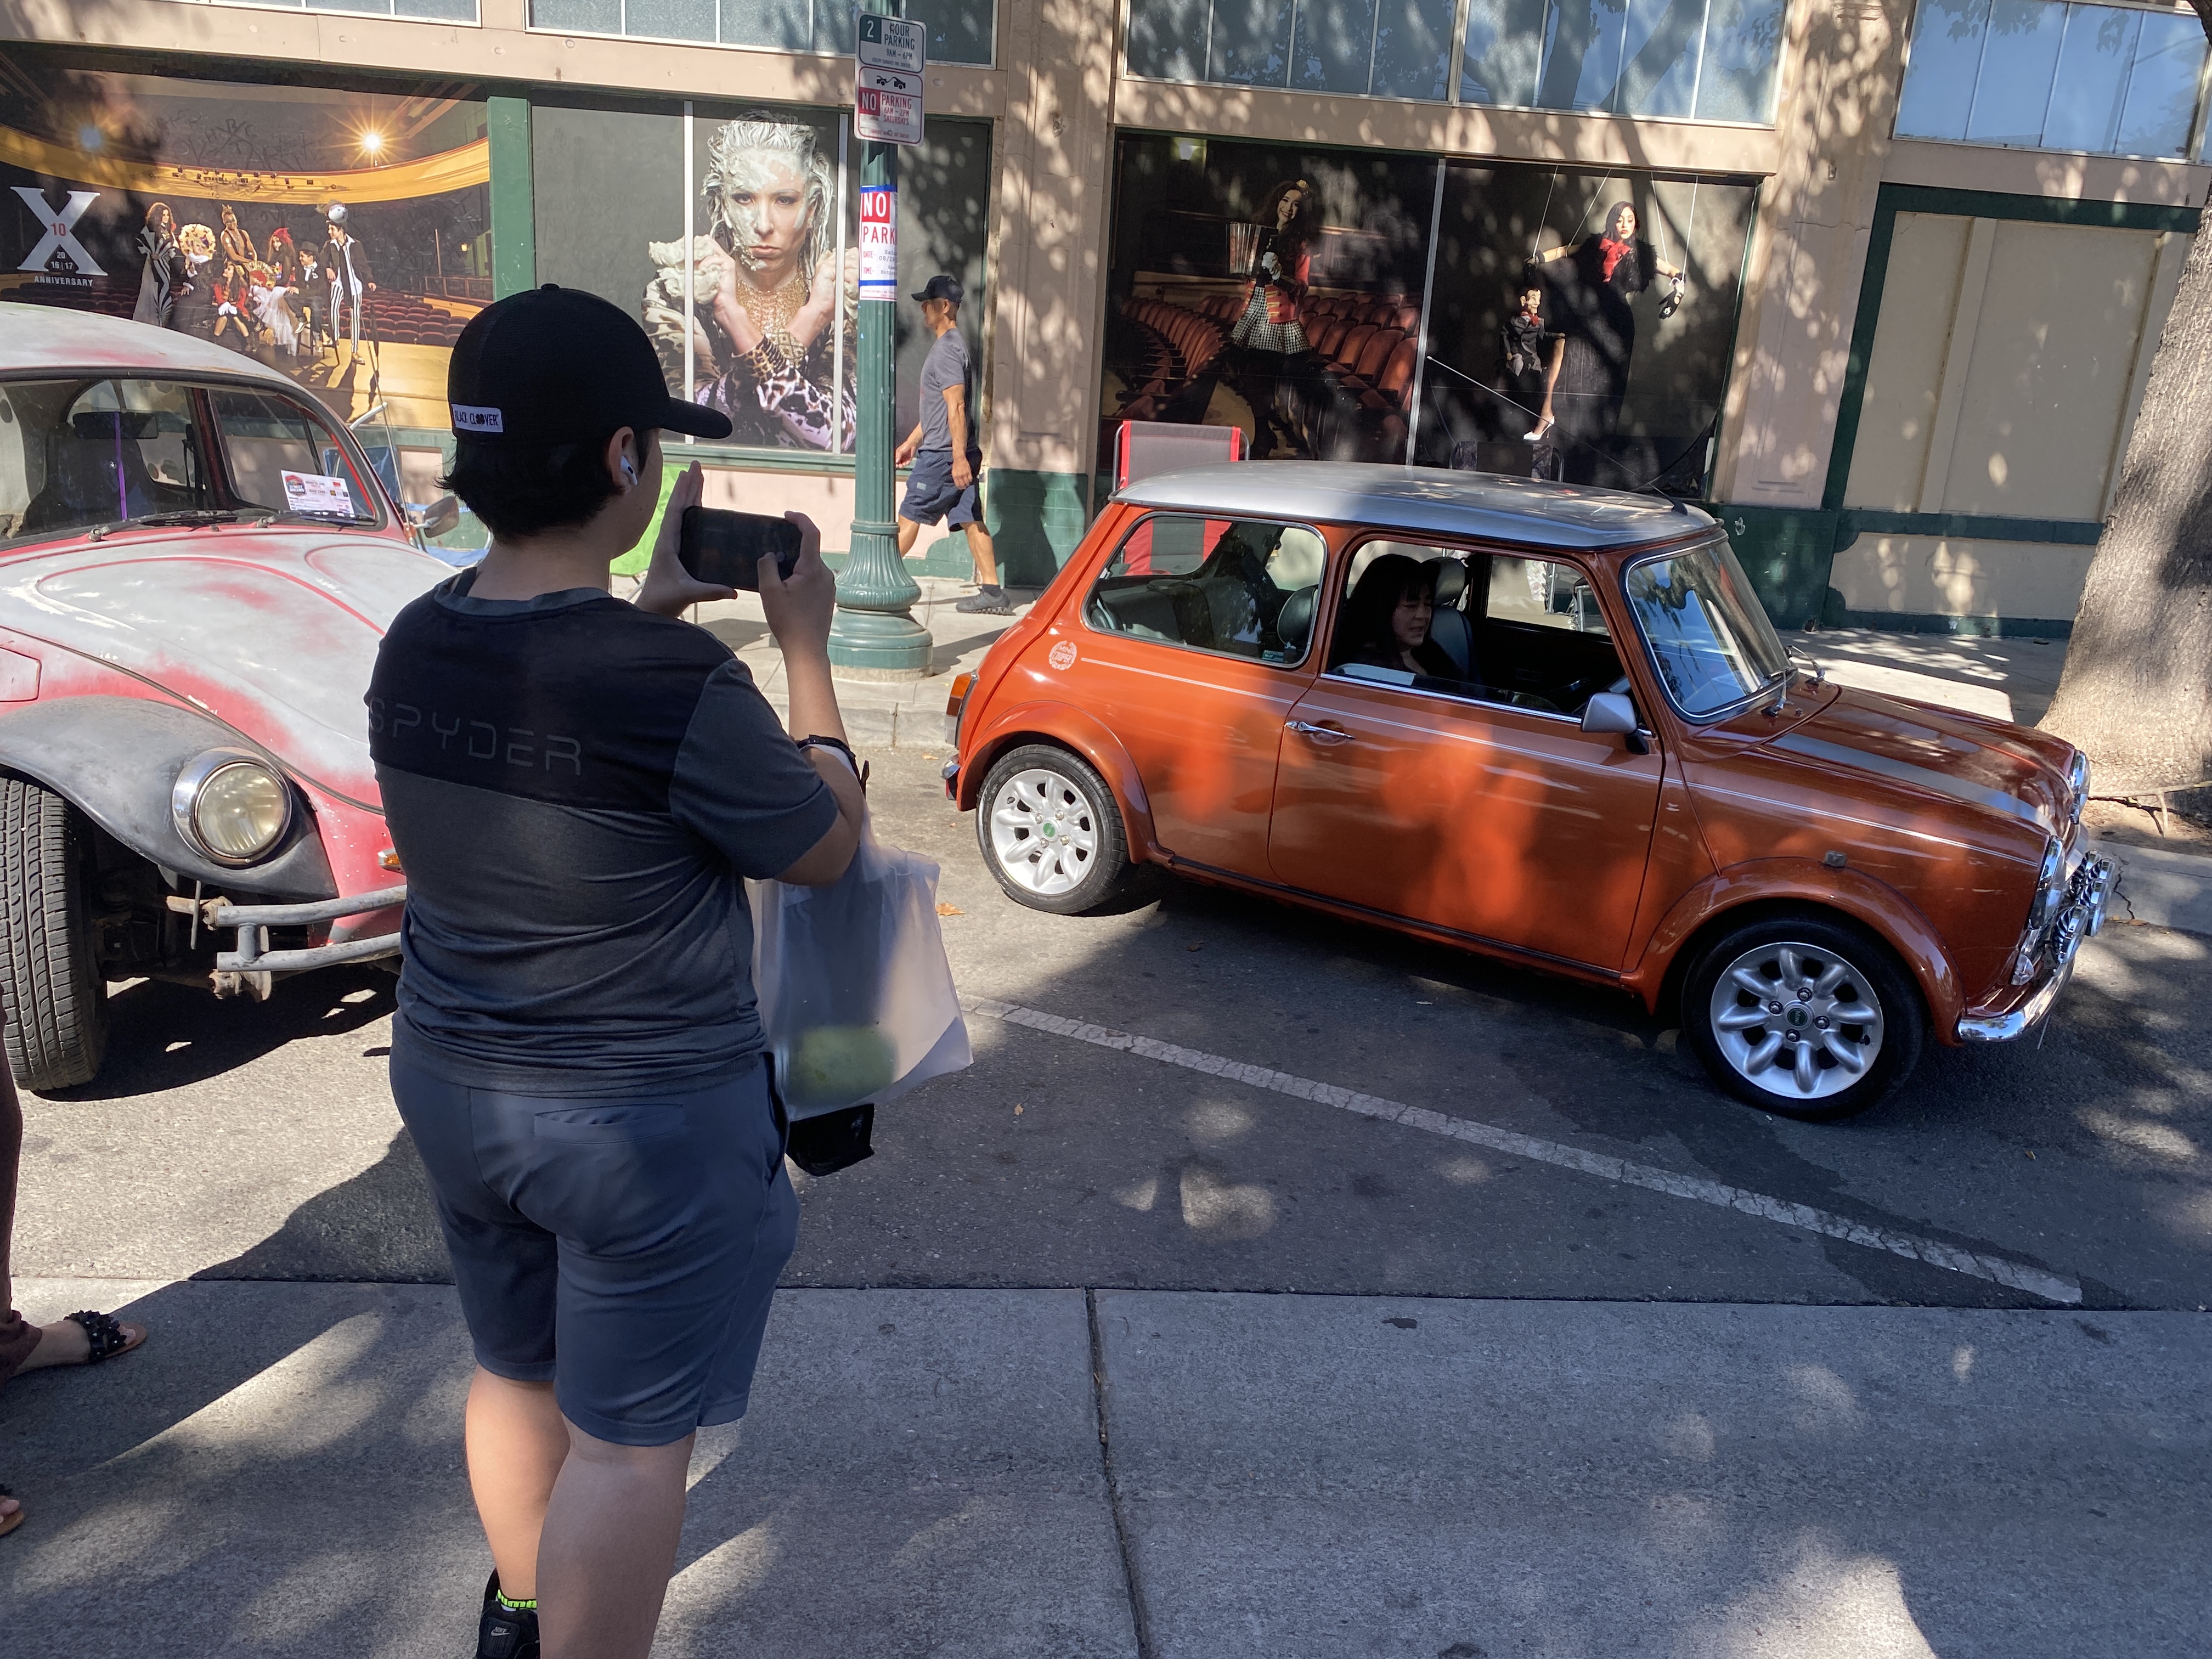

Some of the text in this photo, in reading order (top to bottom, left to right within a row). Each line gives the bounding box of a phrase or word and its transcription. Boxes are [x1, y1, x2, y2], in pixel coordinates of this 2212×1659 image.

[867, 20, 910, 38] 2 HOUR
[884, 34, 915, 50] PARKING
[886, 48, 896, 58] 9AM
[902, 52, 912, 60] 6PM
[862, 92, 912, 111] NO PARKING
[884, 115, 909, 125] SATURDAYS
[864, 193, 887, 217] NO
[10, 186, 108, 276] X
[50, 223, 66, 236] 10
[57, 251, 66, 259] 20
[35, 276, 93, 286] ANNIVERSARY
[370, 697, 582, 775] SPYDER
